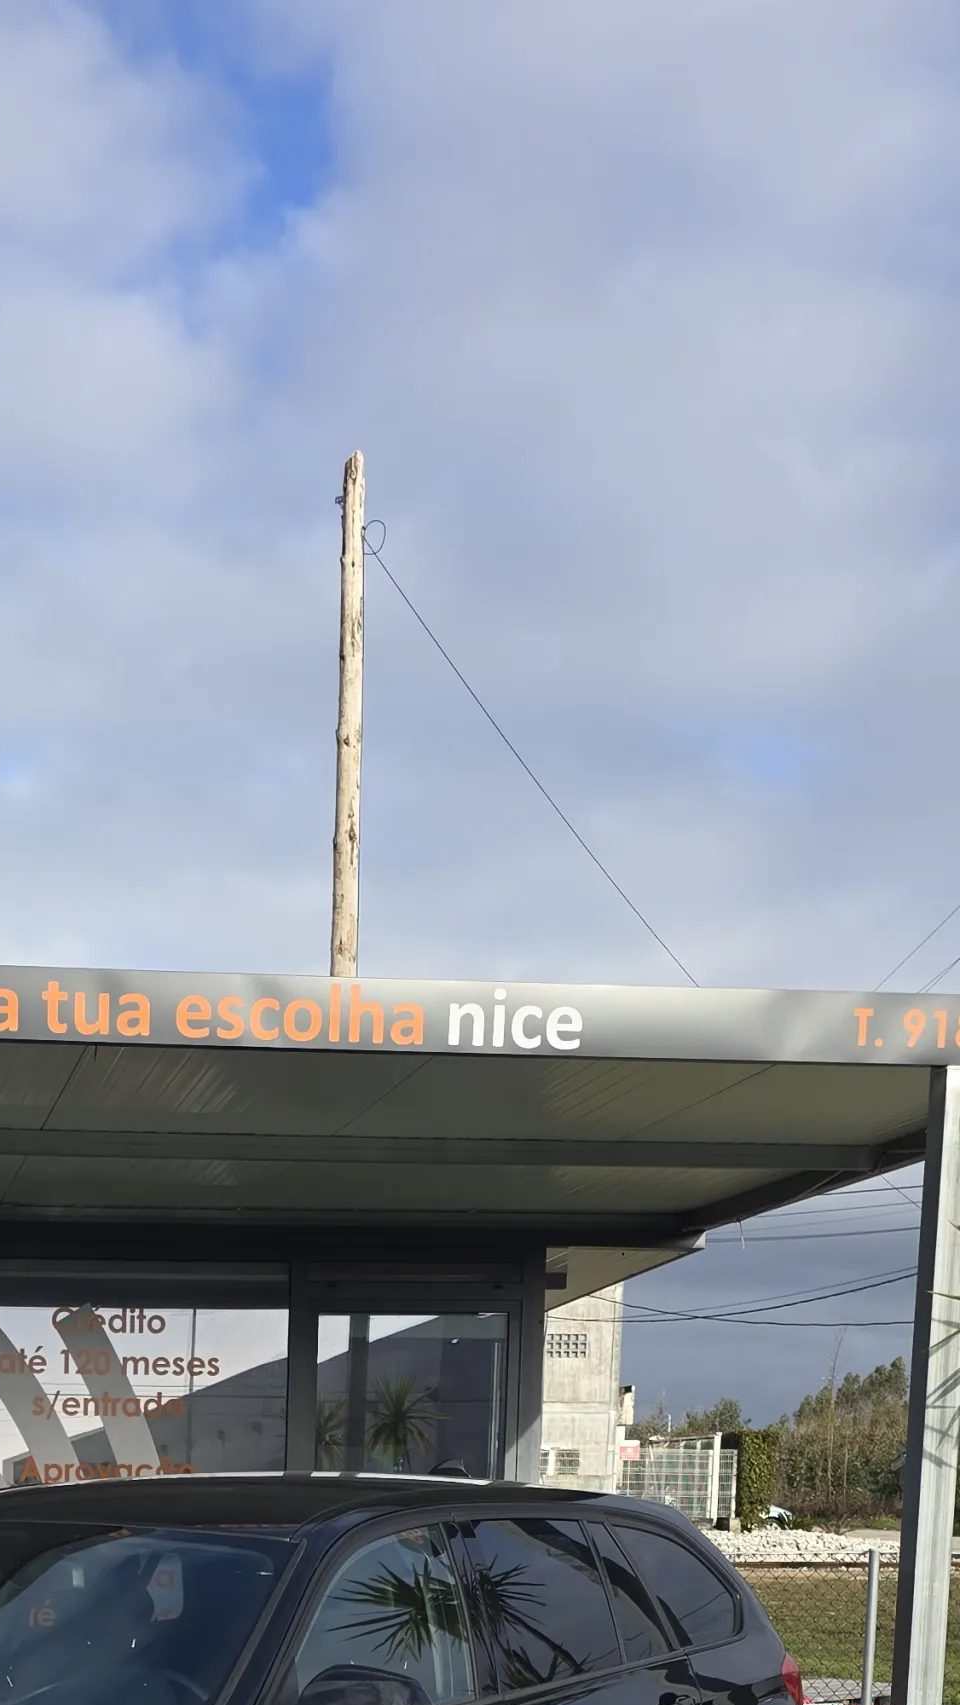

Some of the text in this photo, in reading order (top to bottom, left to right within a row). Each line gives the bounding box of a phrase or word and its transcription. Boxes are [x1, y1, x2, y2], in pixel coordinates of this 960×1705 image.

[42, 981, 151, 1037] tua
[176, 984, 424, 1046] escolha
[447, 988, 583, 1050] nice
[853, 1007, 960, 1050] T. 91
[52, 1305, 167, 1335] Crédito
[60, 1349, 112, 1376] 120
[123, 1355, 221, 1377] meses
[32, 1390, 185, 1420] s/entrada
